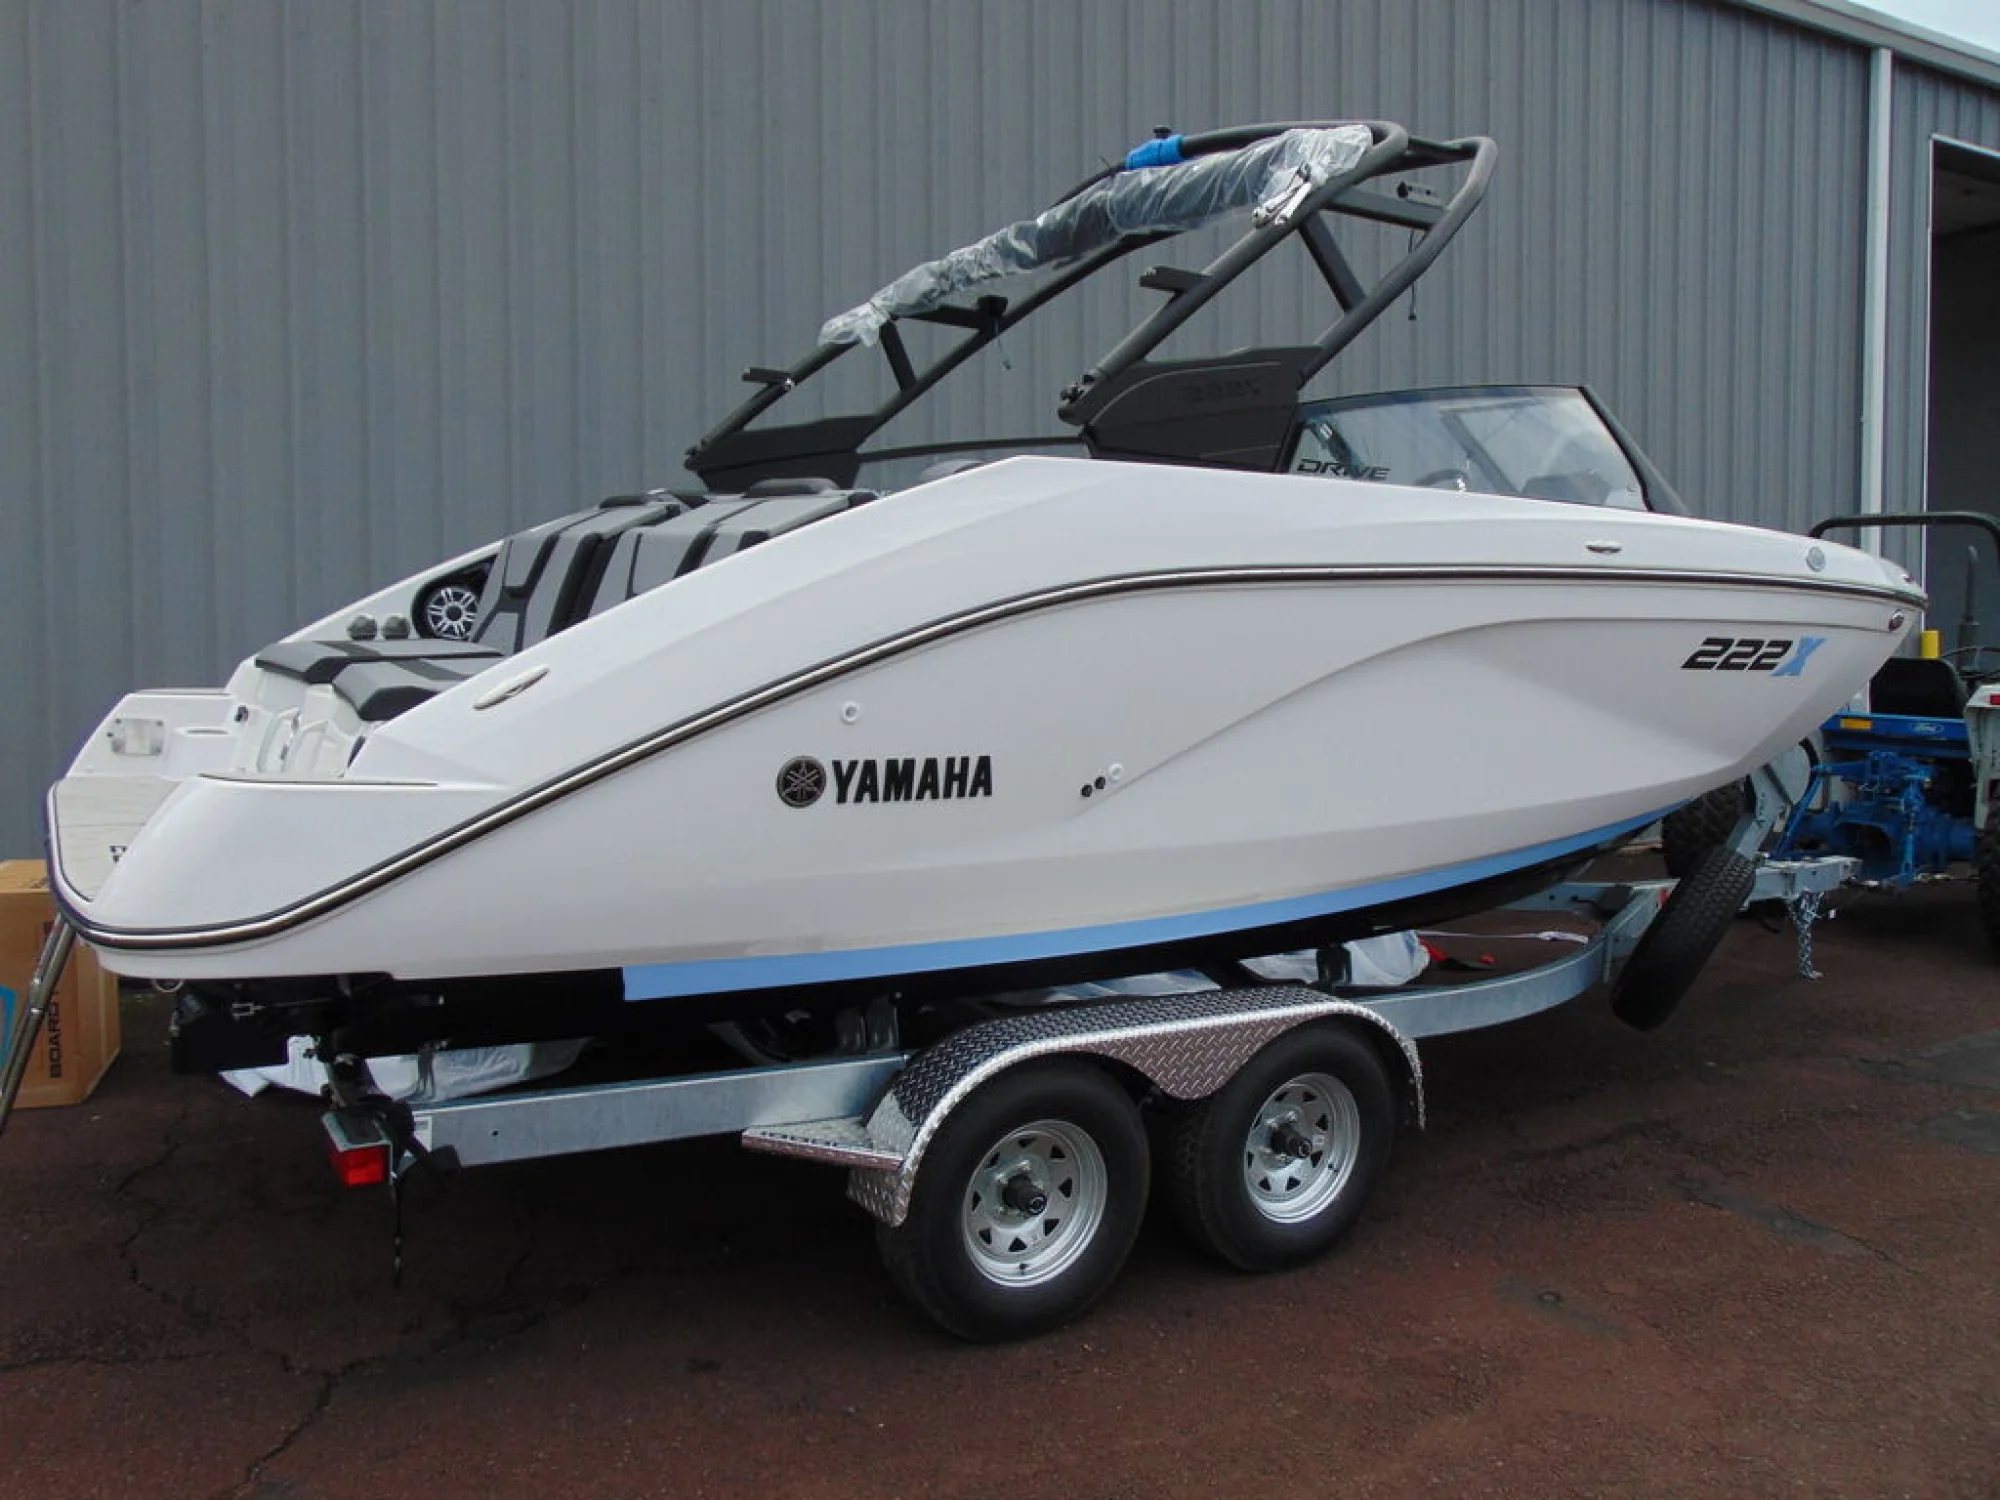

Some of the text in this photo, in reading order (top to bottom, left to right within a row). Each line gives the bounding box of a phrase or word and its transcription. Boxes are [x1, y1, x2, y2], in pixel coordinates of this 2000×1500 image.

[1297, 459, 1391, 481] DRIVE
[1680, 637, 1827, 676] 222X
[832, 755, 992, 804] YAMAHA
